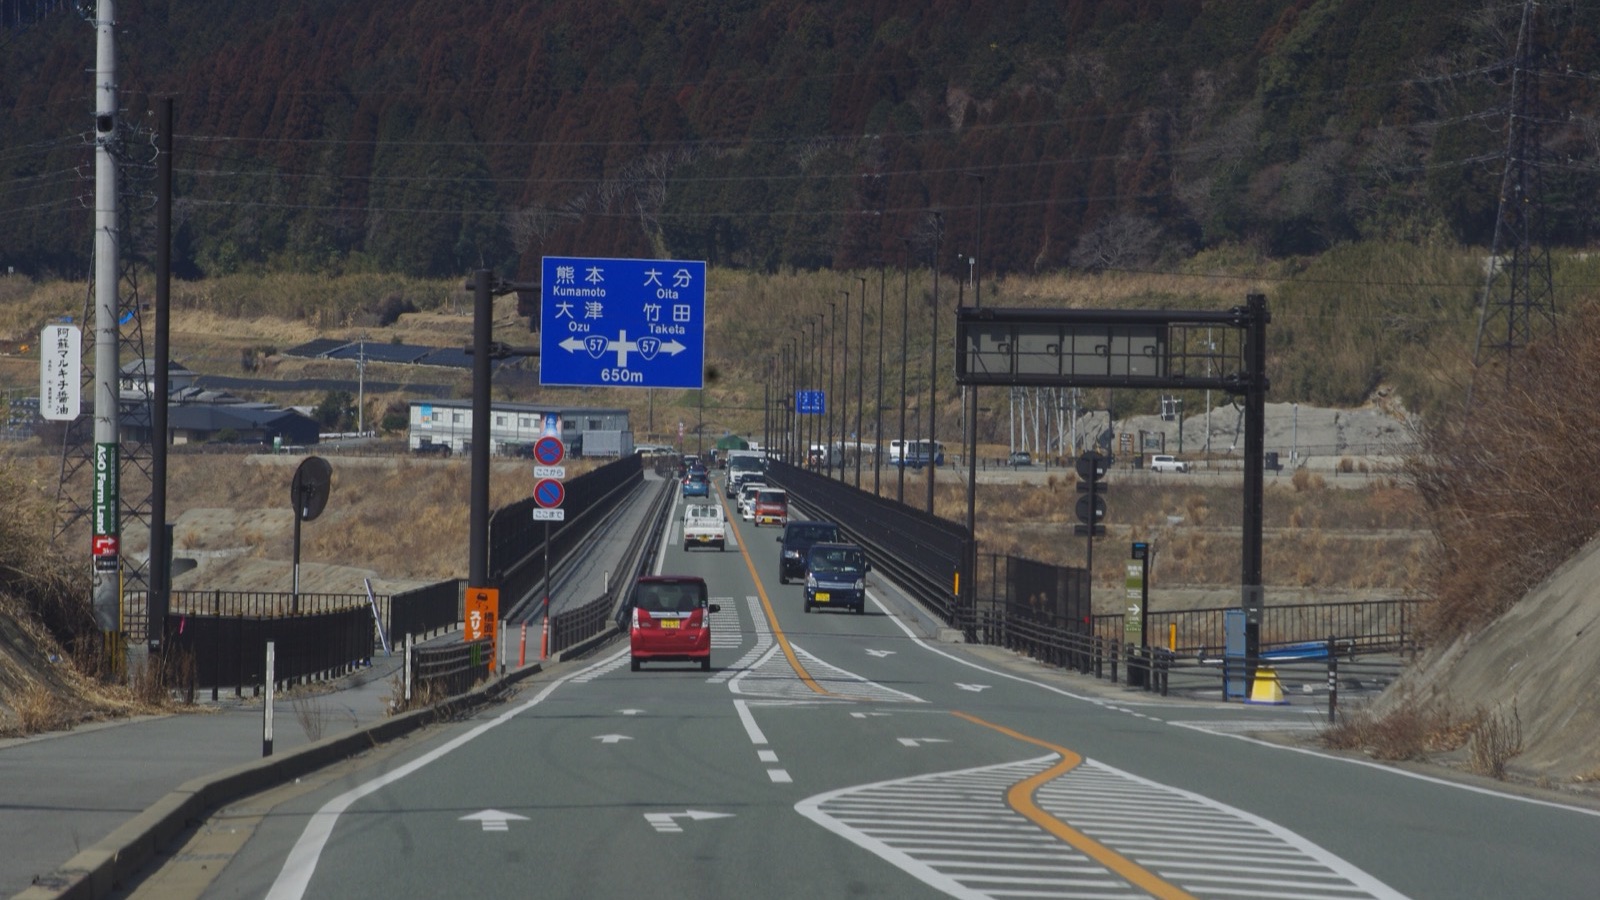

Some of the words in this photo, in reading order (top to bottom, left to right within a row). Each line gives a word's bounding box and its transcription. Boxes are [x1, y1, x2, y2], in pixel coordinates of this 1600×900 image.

[556, 265, 605, 285] 熊本
[643, 267, 692, 288] 大分
[553, 285, 606, 297] Kumamoto
[656, 288, 679, 299] Oita
[555, 301, 604, 320] 大津
[643, 302, 691, 322] 竹田
[568, 320, 590, 332] Ozu
[648, 323, 685, 335] Taketa
[589, 338, 604, 352] 57
[642, 340, 656, 353] 57
[601, 368, 643, 383] 650m
[536, 468, 564, 477] ここから
[97, 472, 106, 503] Farm
[97, 504, 106, 535] Land
[535, 510, 563, 519] ここまで
[470, 610, 482, 641] スリッ
